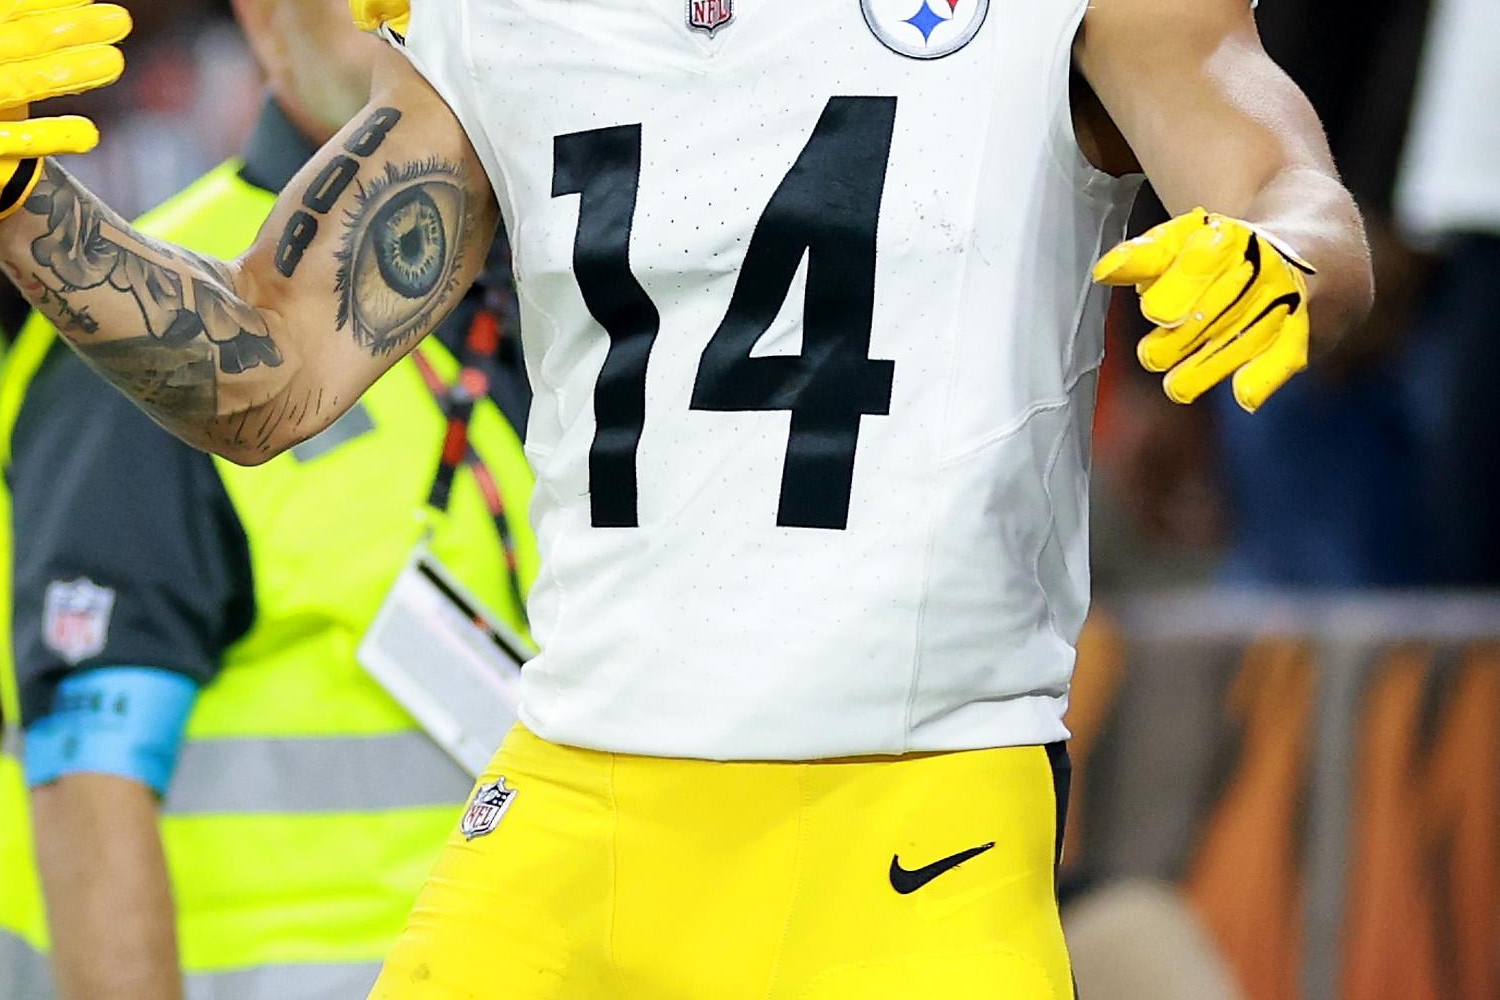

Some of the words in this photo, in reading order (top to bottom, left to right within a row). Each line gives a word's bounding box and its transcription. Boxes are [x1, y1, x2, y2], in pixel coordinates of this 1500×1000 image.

[275, 107, 402, 278] 808
[551, 95, 898, 530] 14
[466, 804, 493, 829] NFL
